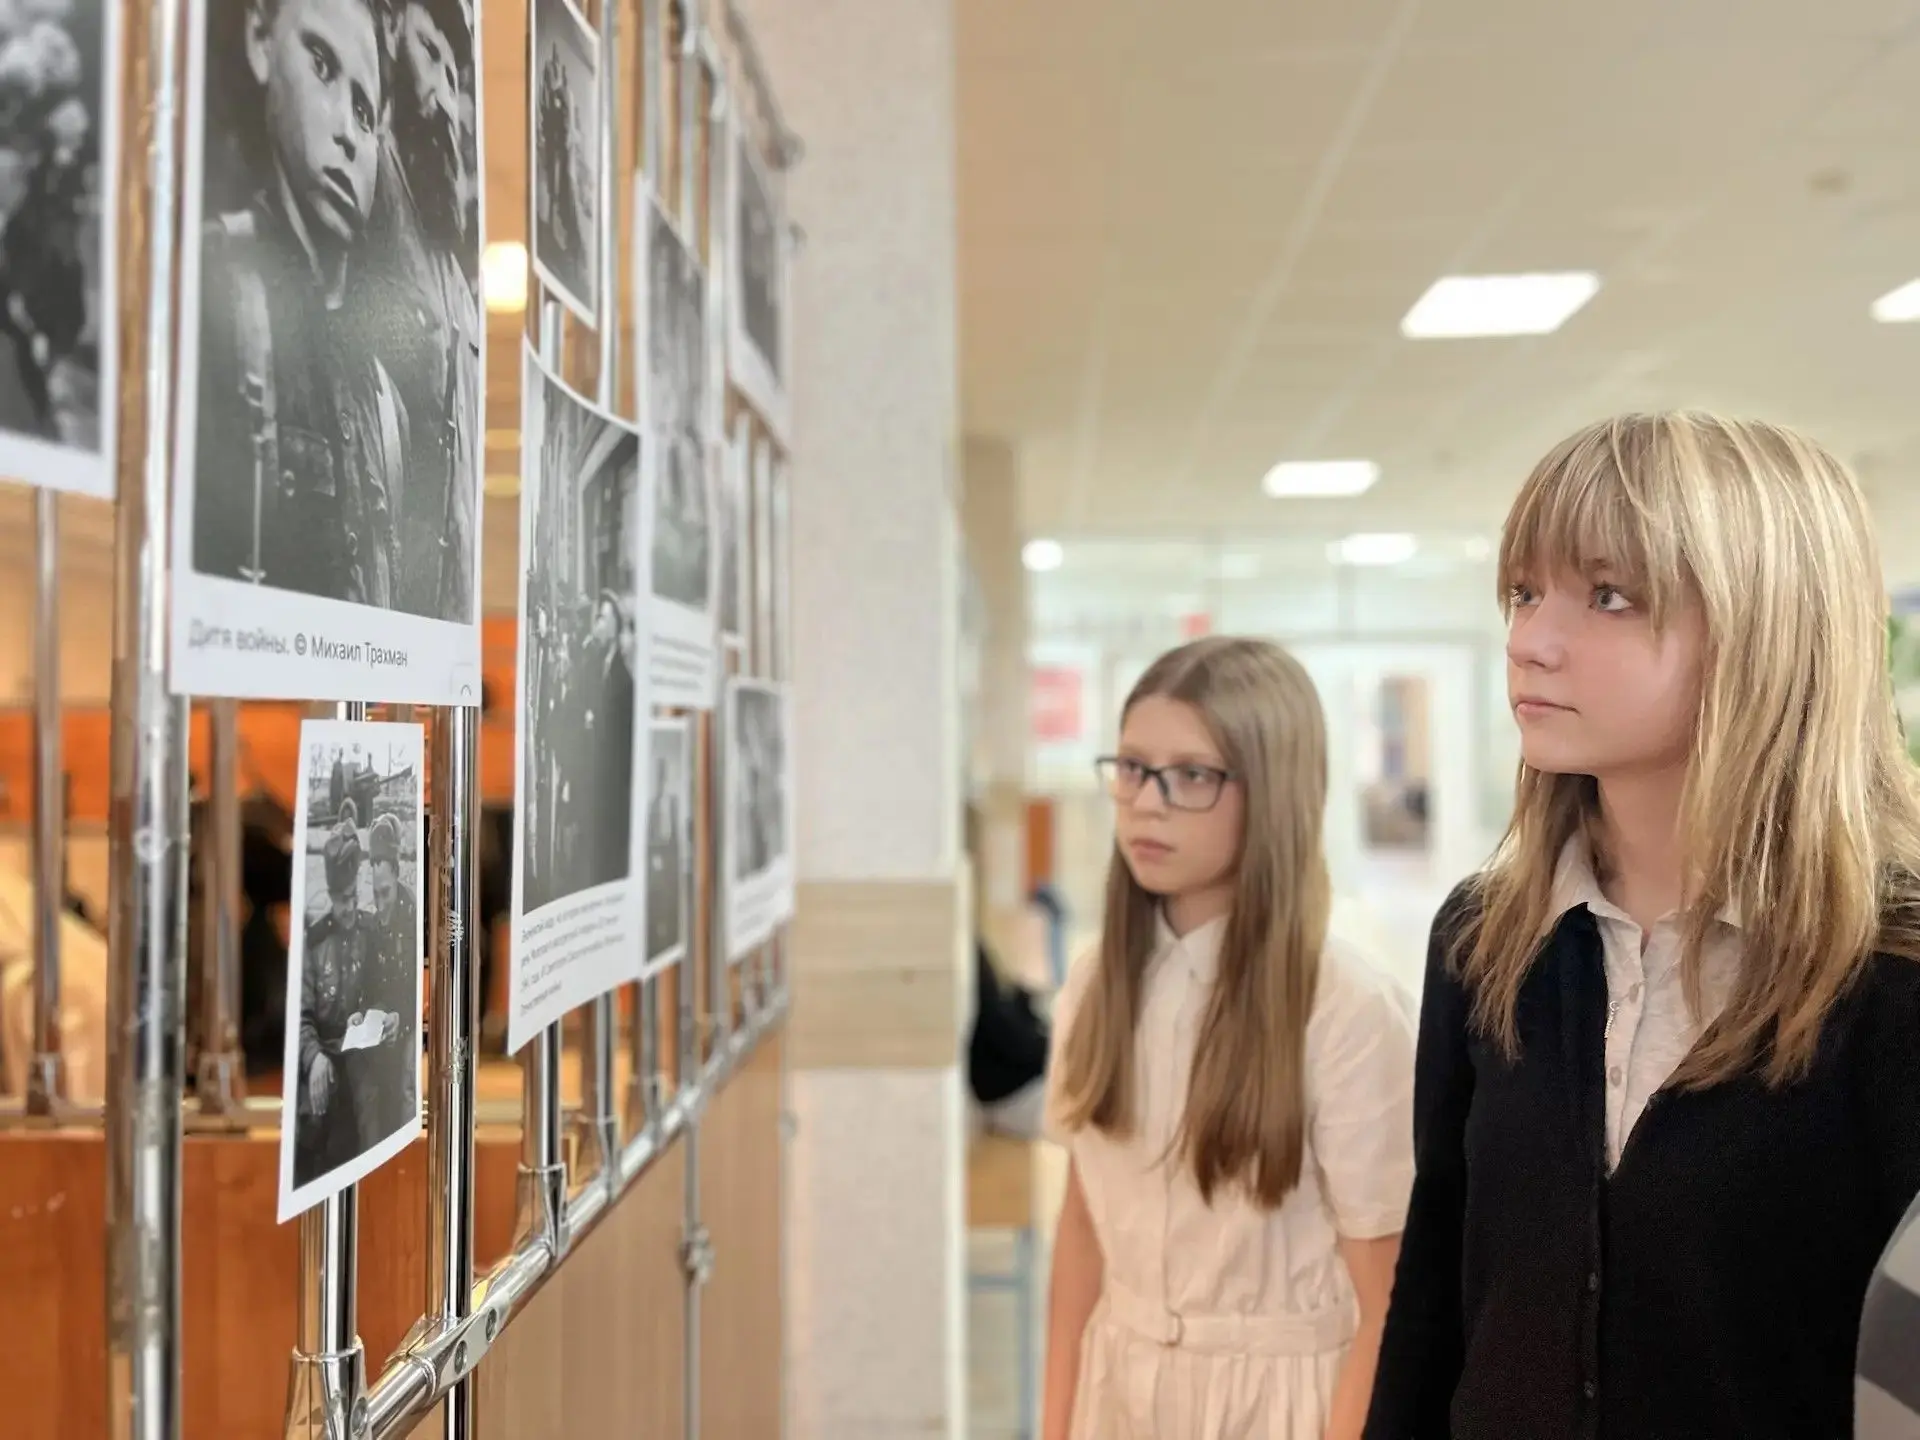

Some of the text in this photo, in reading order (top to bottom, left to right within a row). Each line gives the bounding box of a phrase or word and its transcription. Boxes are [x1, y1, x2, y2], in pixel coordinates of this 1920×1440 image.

[236, 627, 290, 654] войны.
[311, 634, 361, 661] Михаил
[364, 641, 408, 669] Трахман
